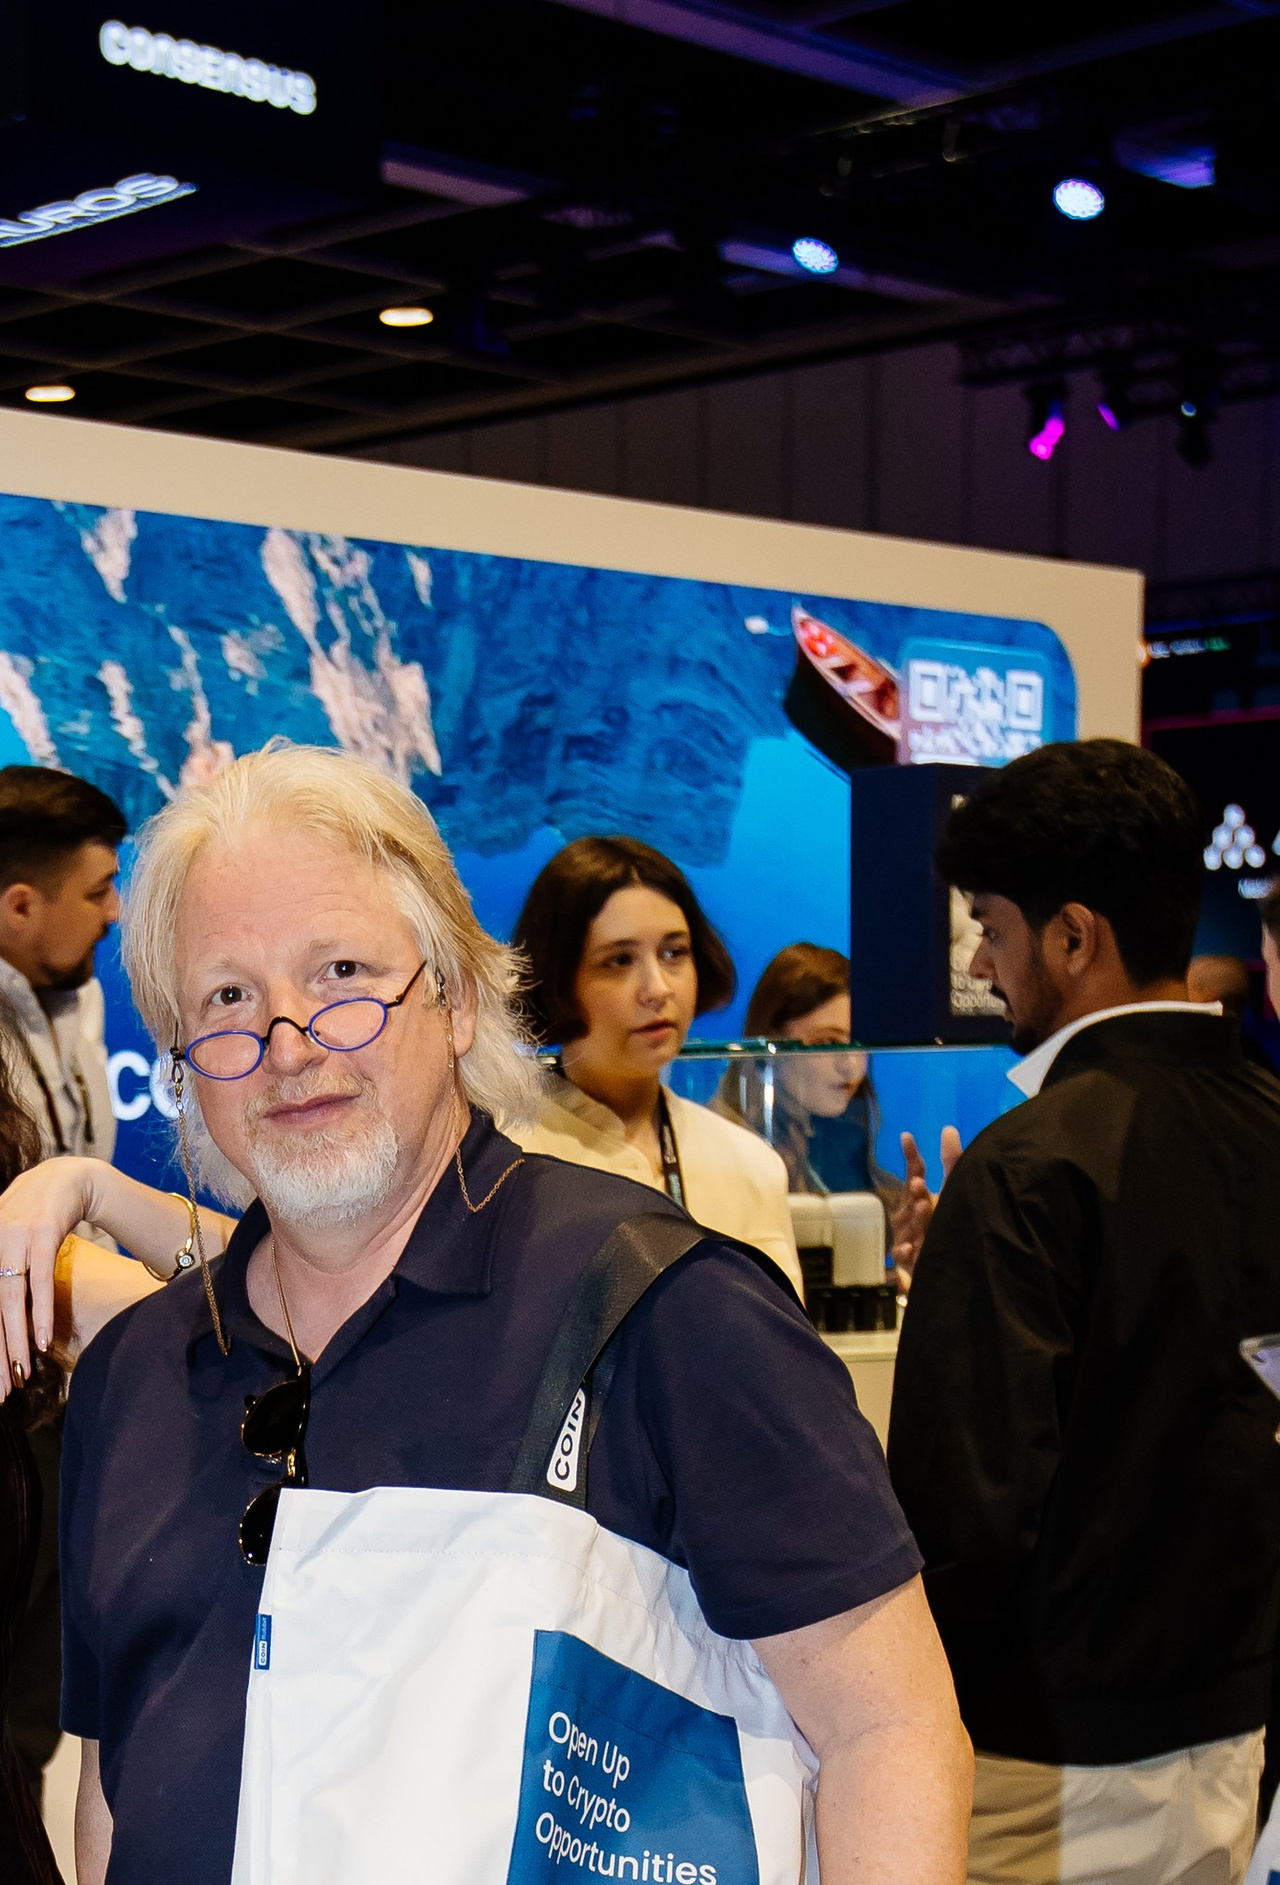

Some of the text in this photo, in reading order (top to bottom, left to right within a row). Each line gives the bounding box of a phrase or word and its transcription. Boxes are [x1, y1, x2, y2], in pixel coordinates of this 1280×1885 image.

[554, 1397, 582, 1481] COIN
[548, 1711, 630, 1789] Open Up
[543, 1759, 631, 1833] to Crypto
